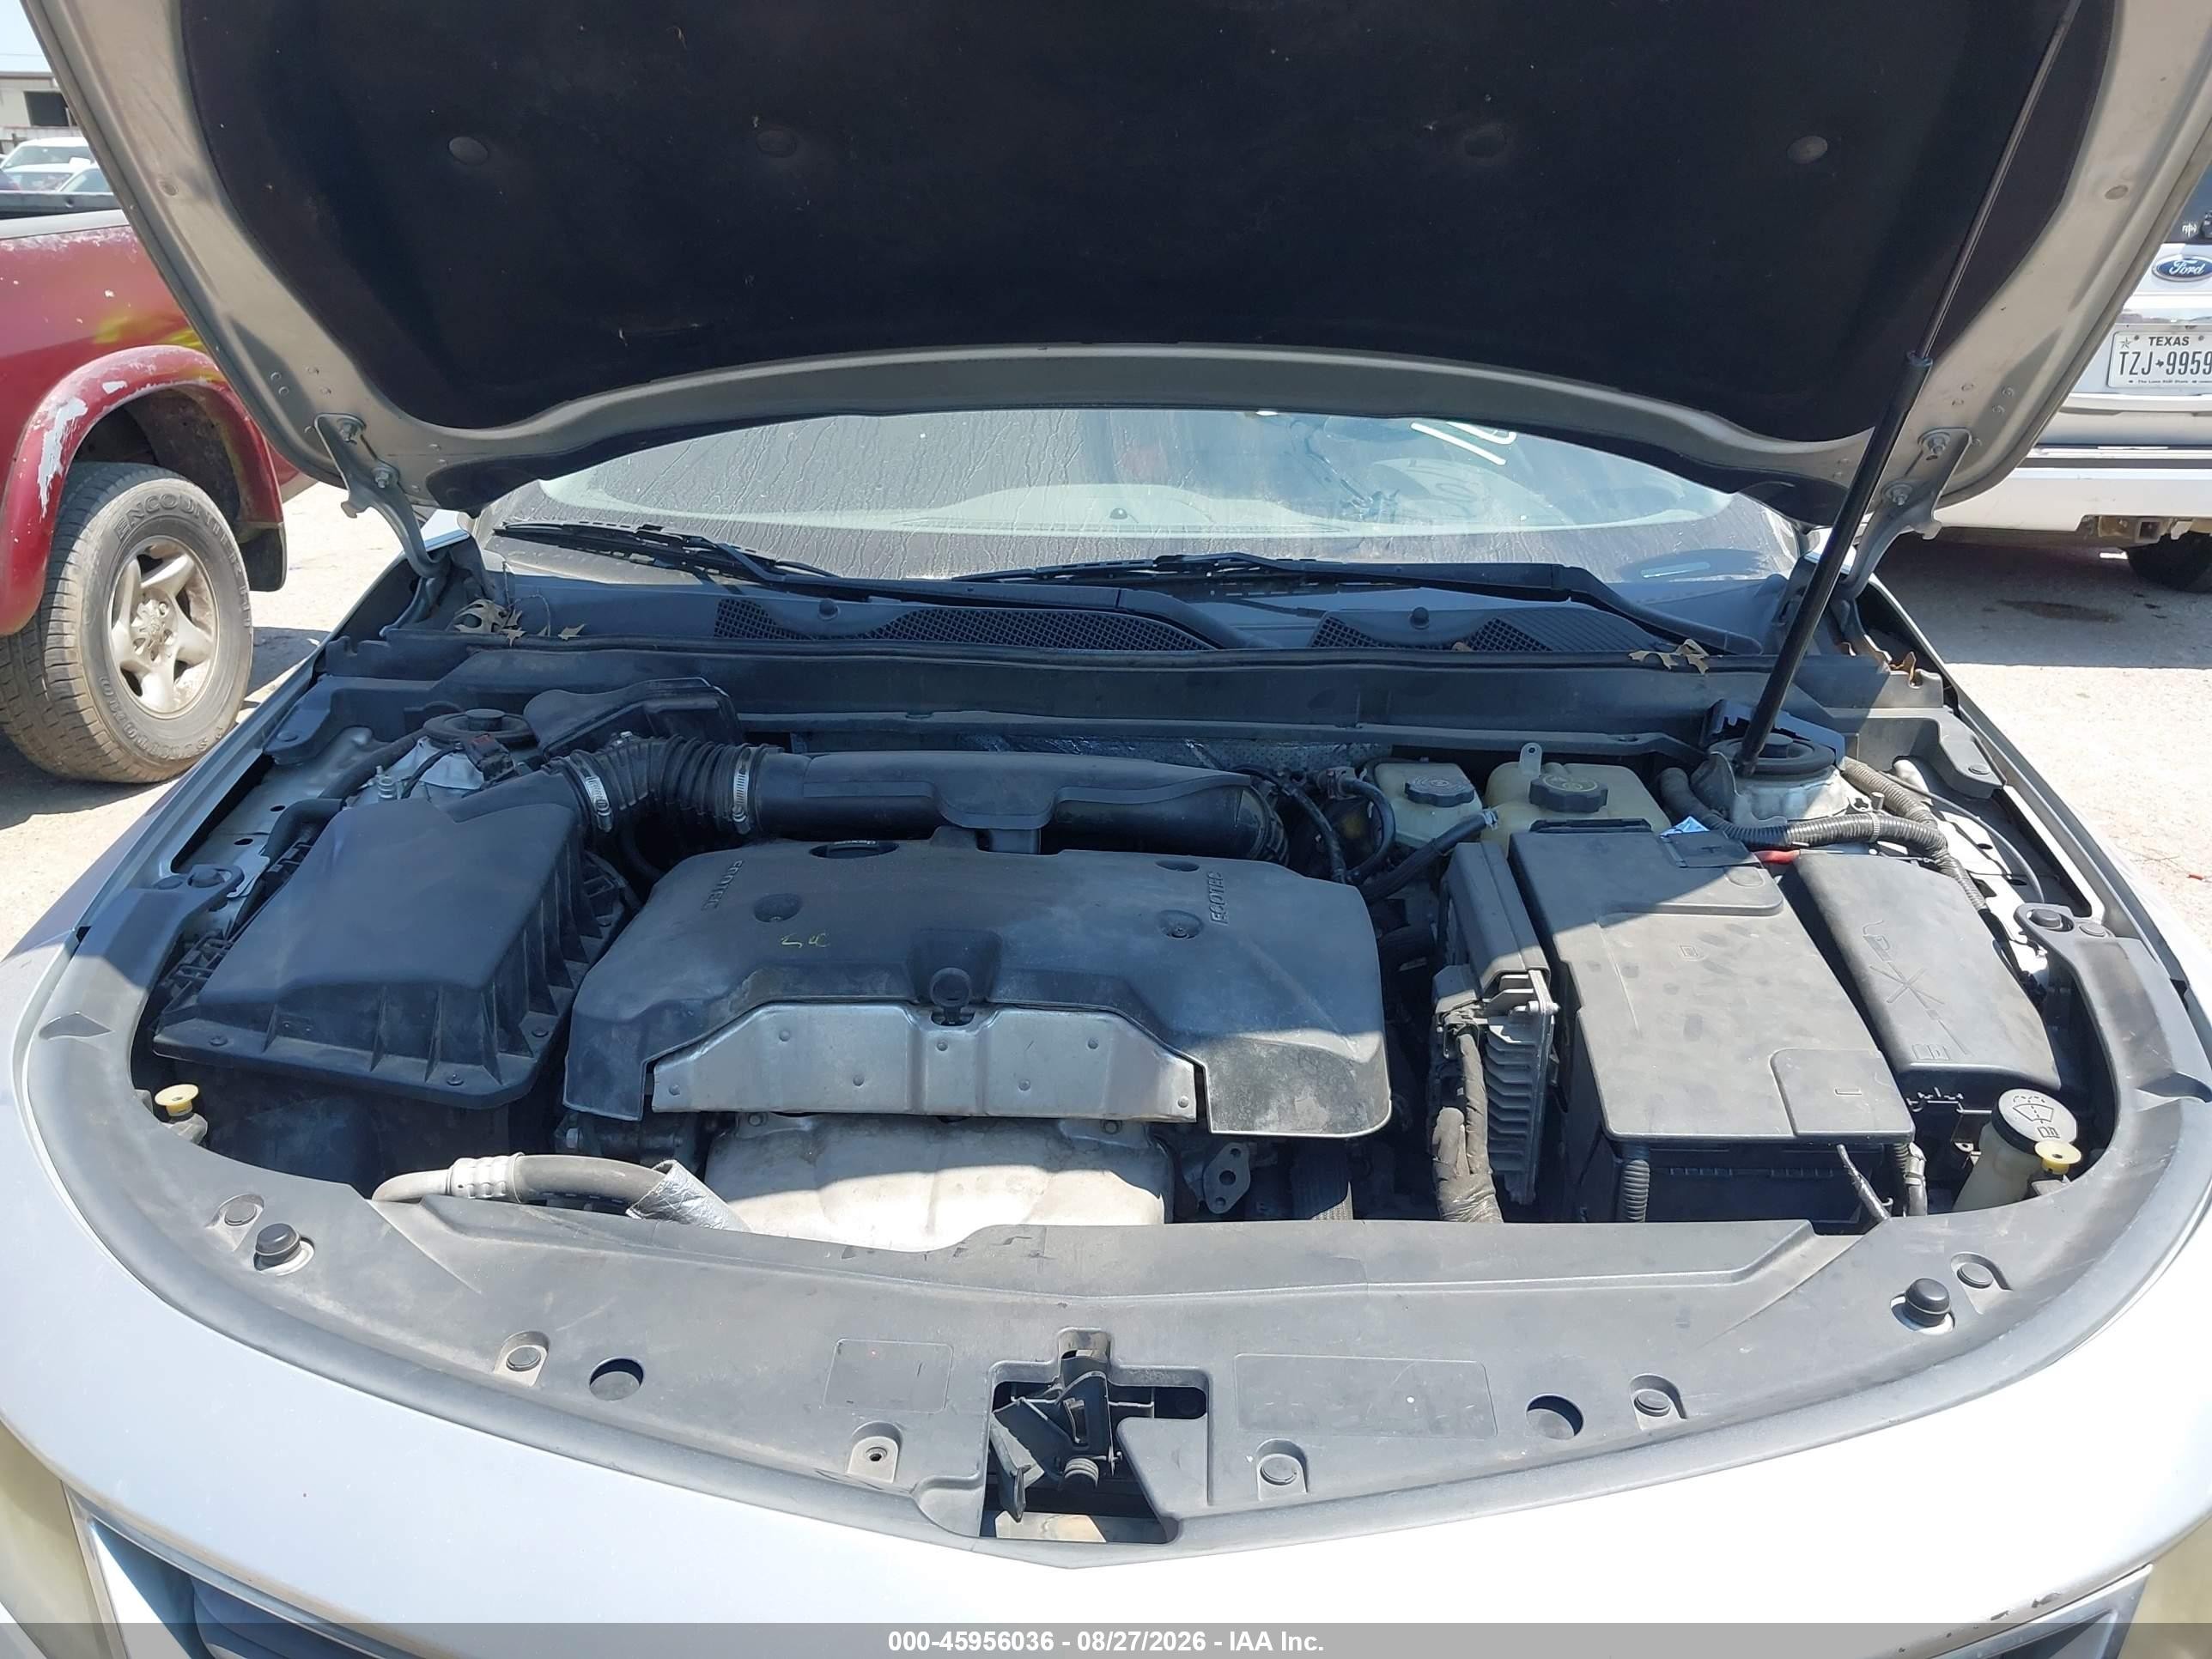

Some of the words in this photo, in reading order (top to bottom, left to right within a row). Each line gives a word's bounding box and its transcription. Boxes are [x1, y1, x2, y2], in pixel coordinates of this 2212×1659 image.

[2169, 259, 2206, 275] Ford
[2148, 336, 2190, 347] TEXAS
[1207, 871, 1229, 927] ECOTEC
